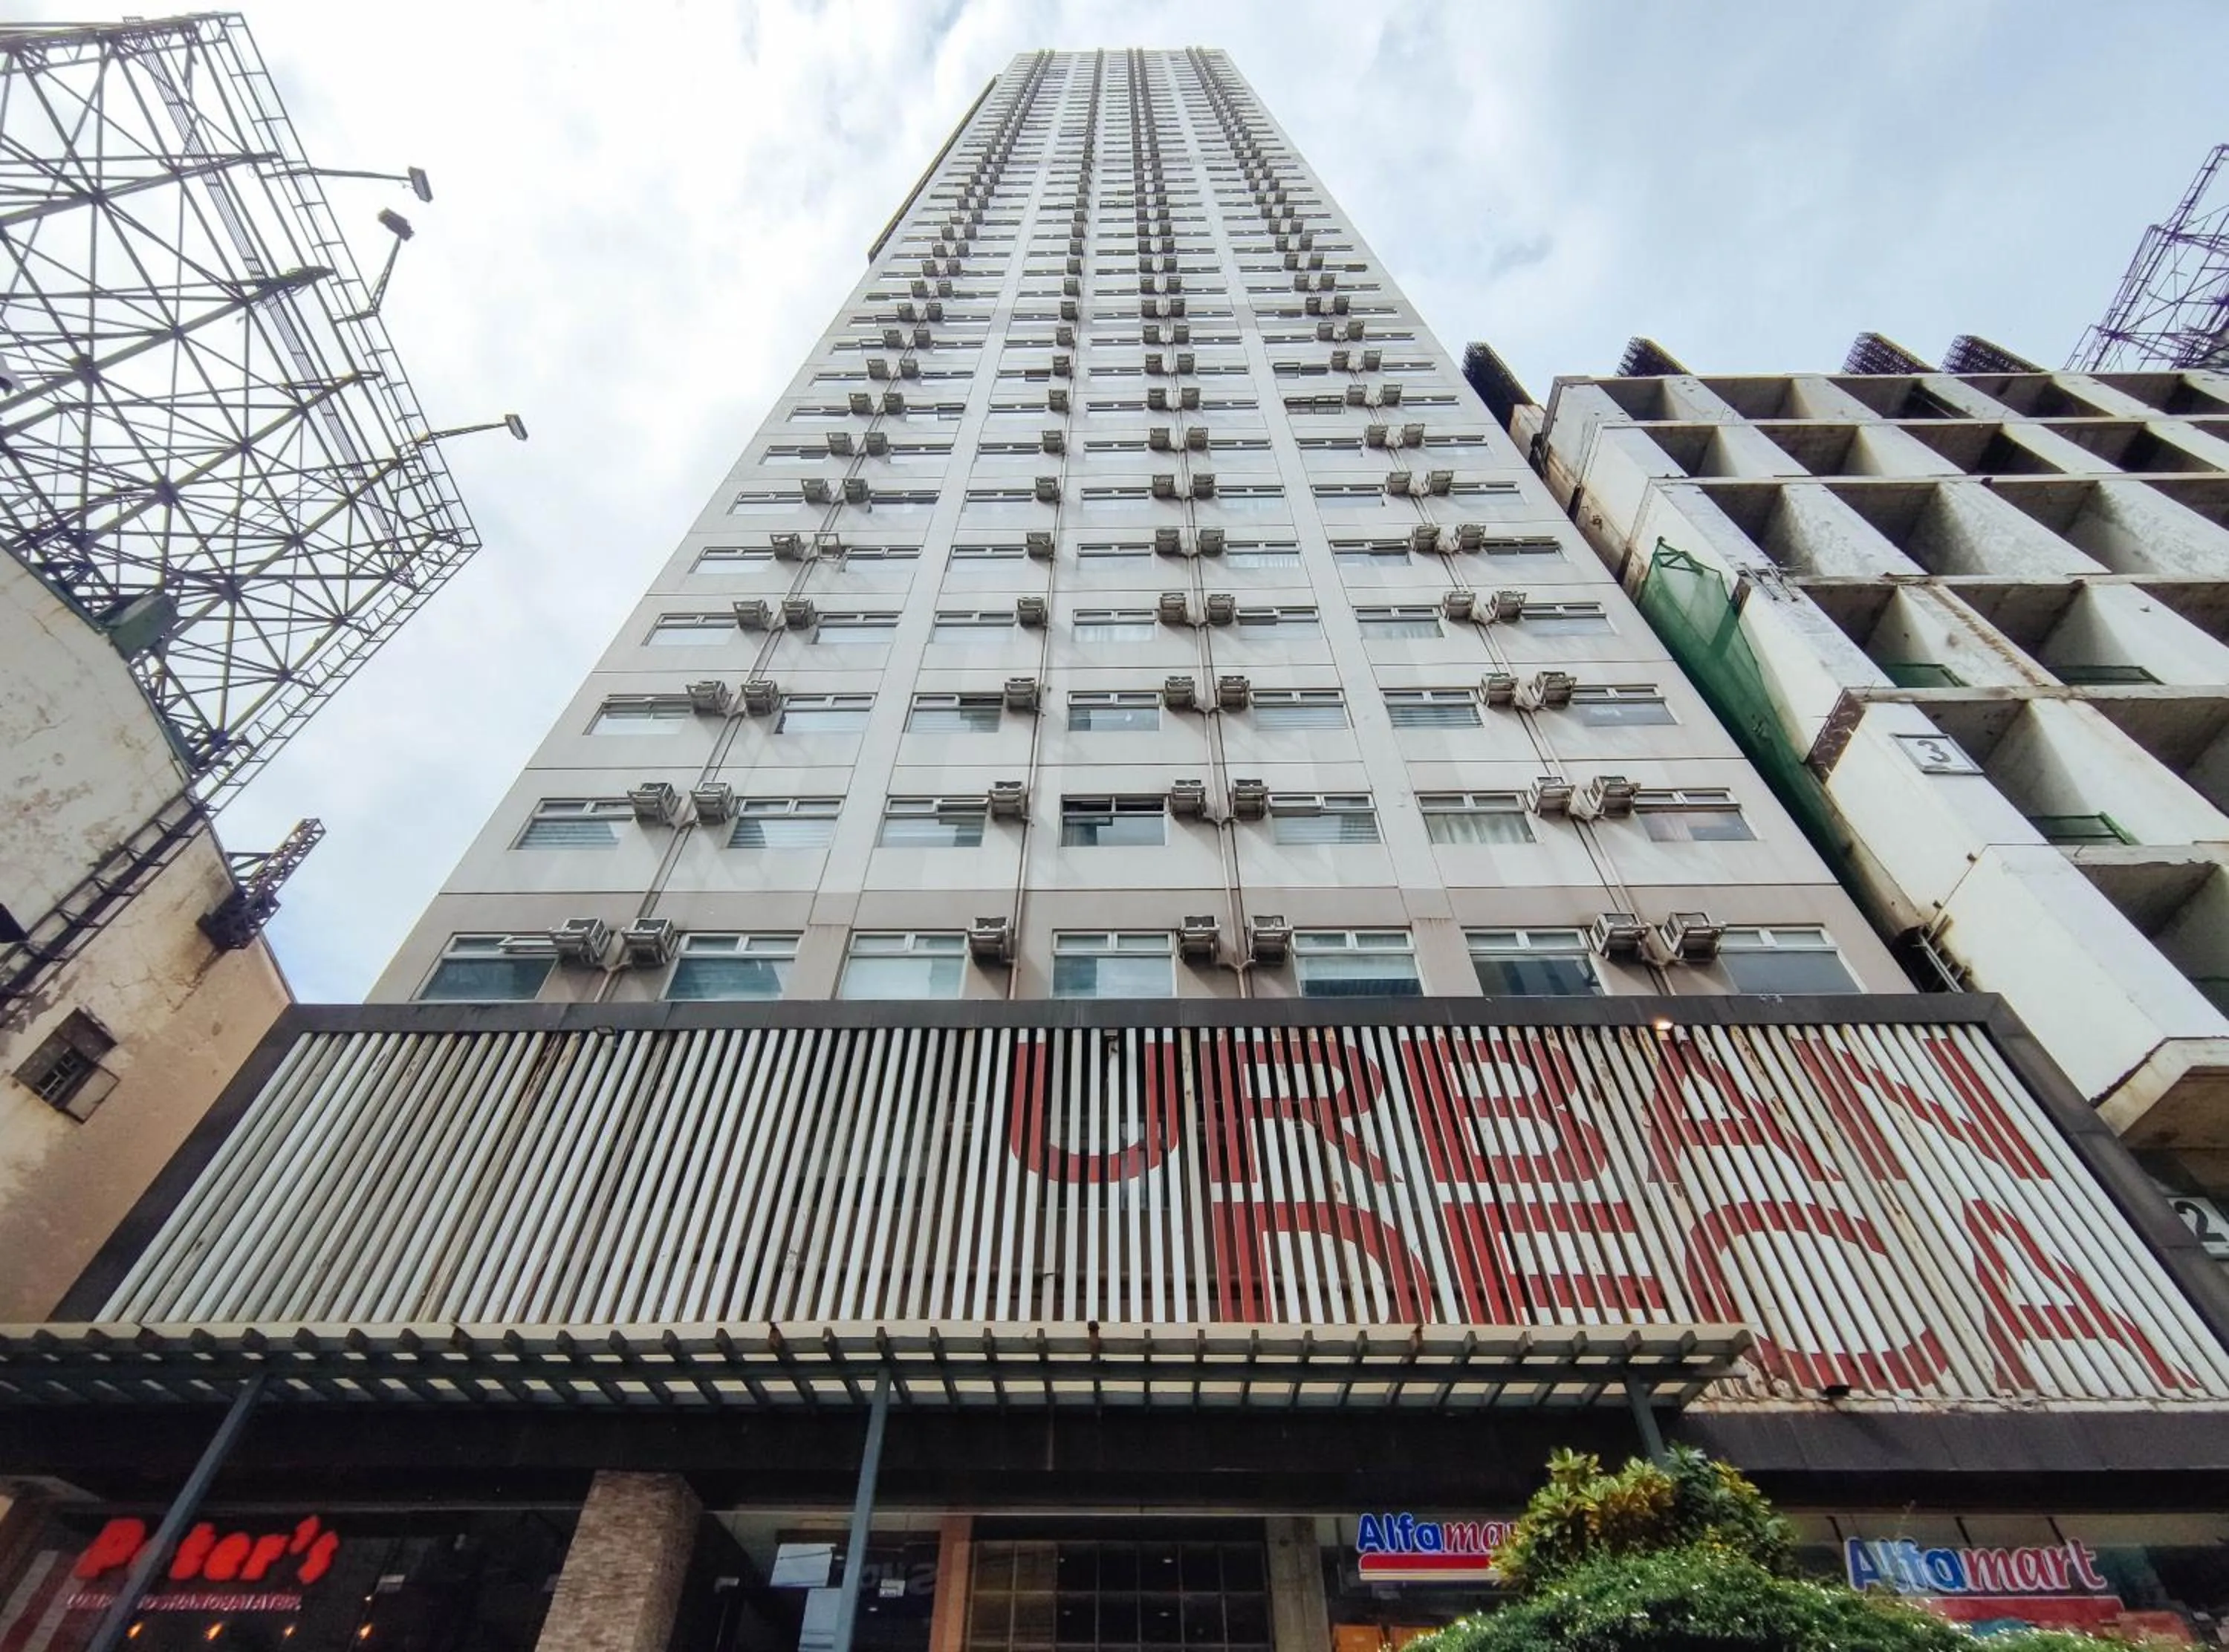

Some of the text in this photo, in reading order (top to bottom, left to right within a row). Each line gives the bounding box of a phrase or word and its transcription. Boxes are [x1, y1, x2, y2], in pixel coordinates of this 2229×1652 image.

[1917, 740, 1951, 762] 3
[1010, 1037, 2049, 1183] URBAN
[1211, 1199, 2196, 1391] DECA
[74, 1515, 339, 1584] Pter's
[1356, 1512, 1520, 1552] Alfama
[1843, 1536, 2107, 1593] Alfamart
